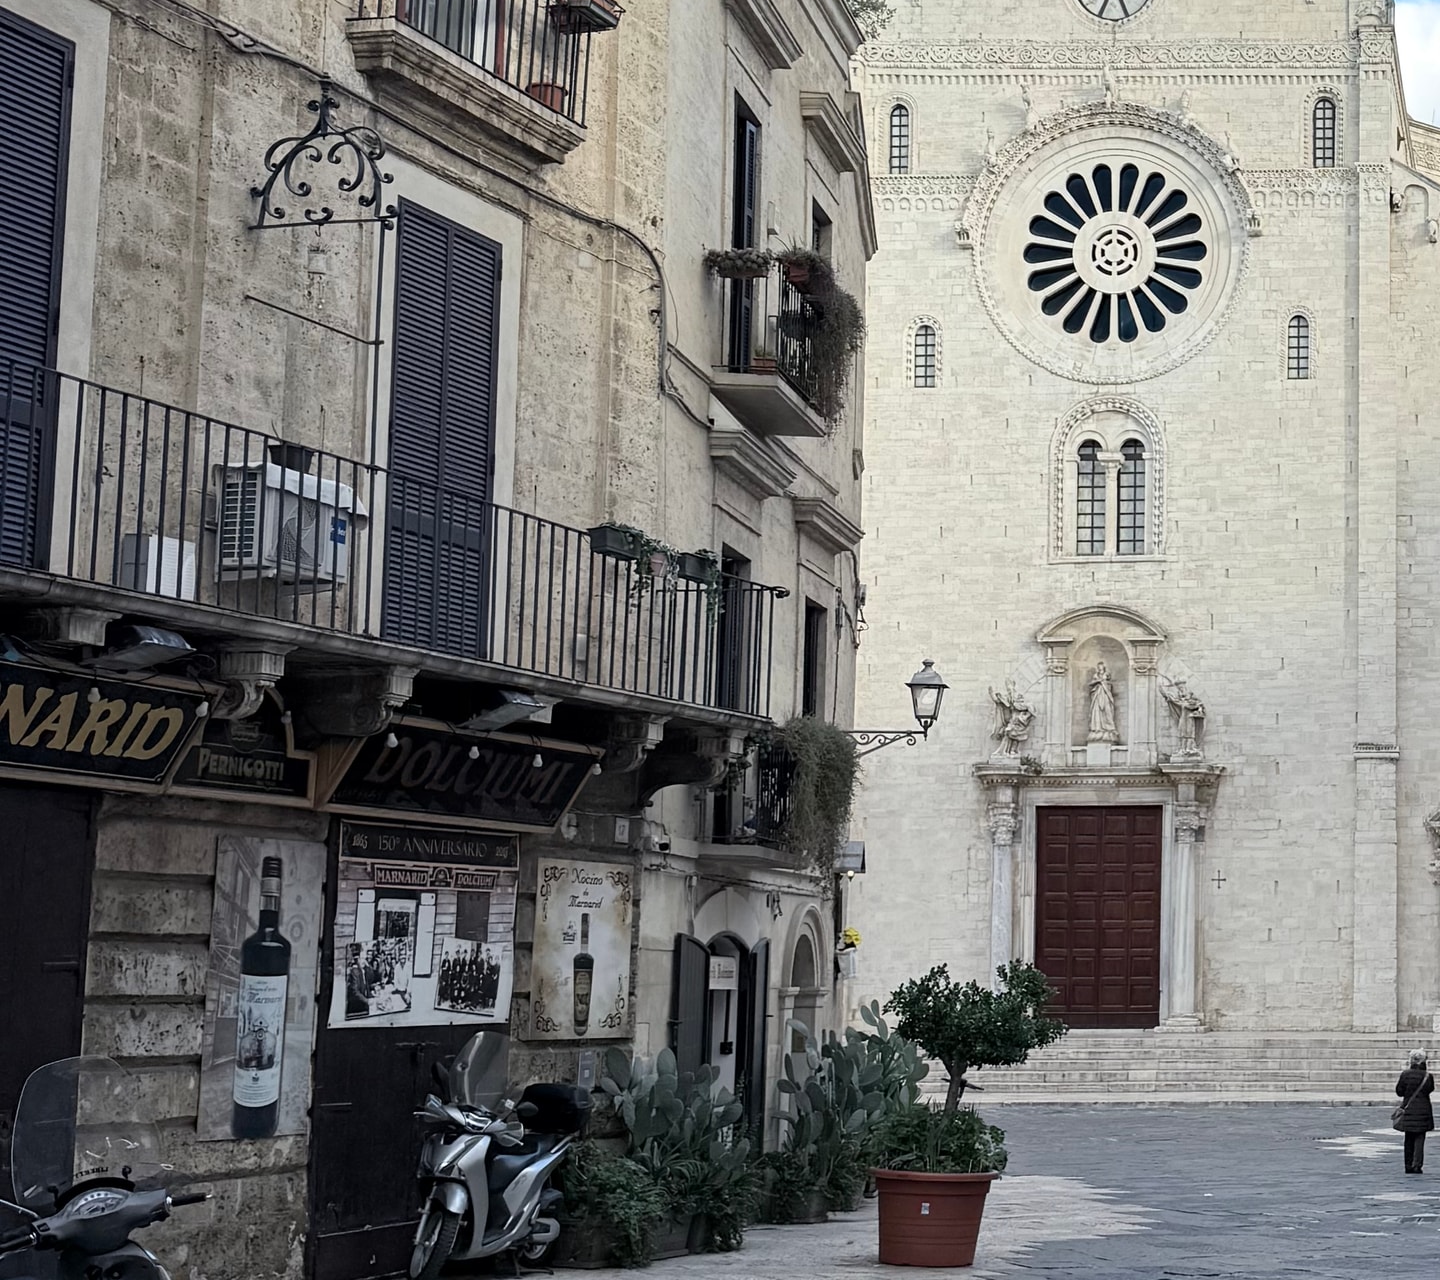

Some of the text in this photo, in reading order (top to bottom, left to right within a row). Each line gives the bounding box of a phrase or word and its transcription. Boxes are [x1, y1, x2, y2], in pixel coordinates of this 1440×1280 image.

[197, 747, 285, 782] PERNIGOTTI
[362, 736, 575, 804] DOLCIUMI
[403, 836, 488, 858] ANNIVERSARIO
[377, 869, 428, 885] MARNARID
[457, 873, 494, 886] DOLCIUMI
[571, 867, 604, 886] Nocino
